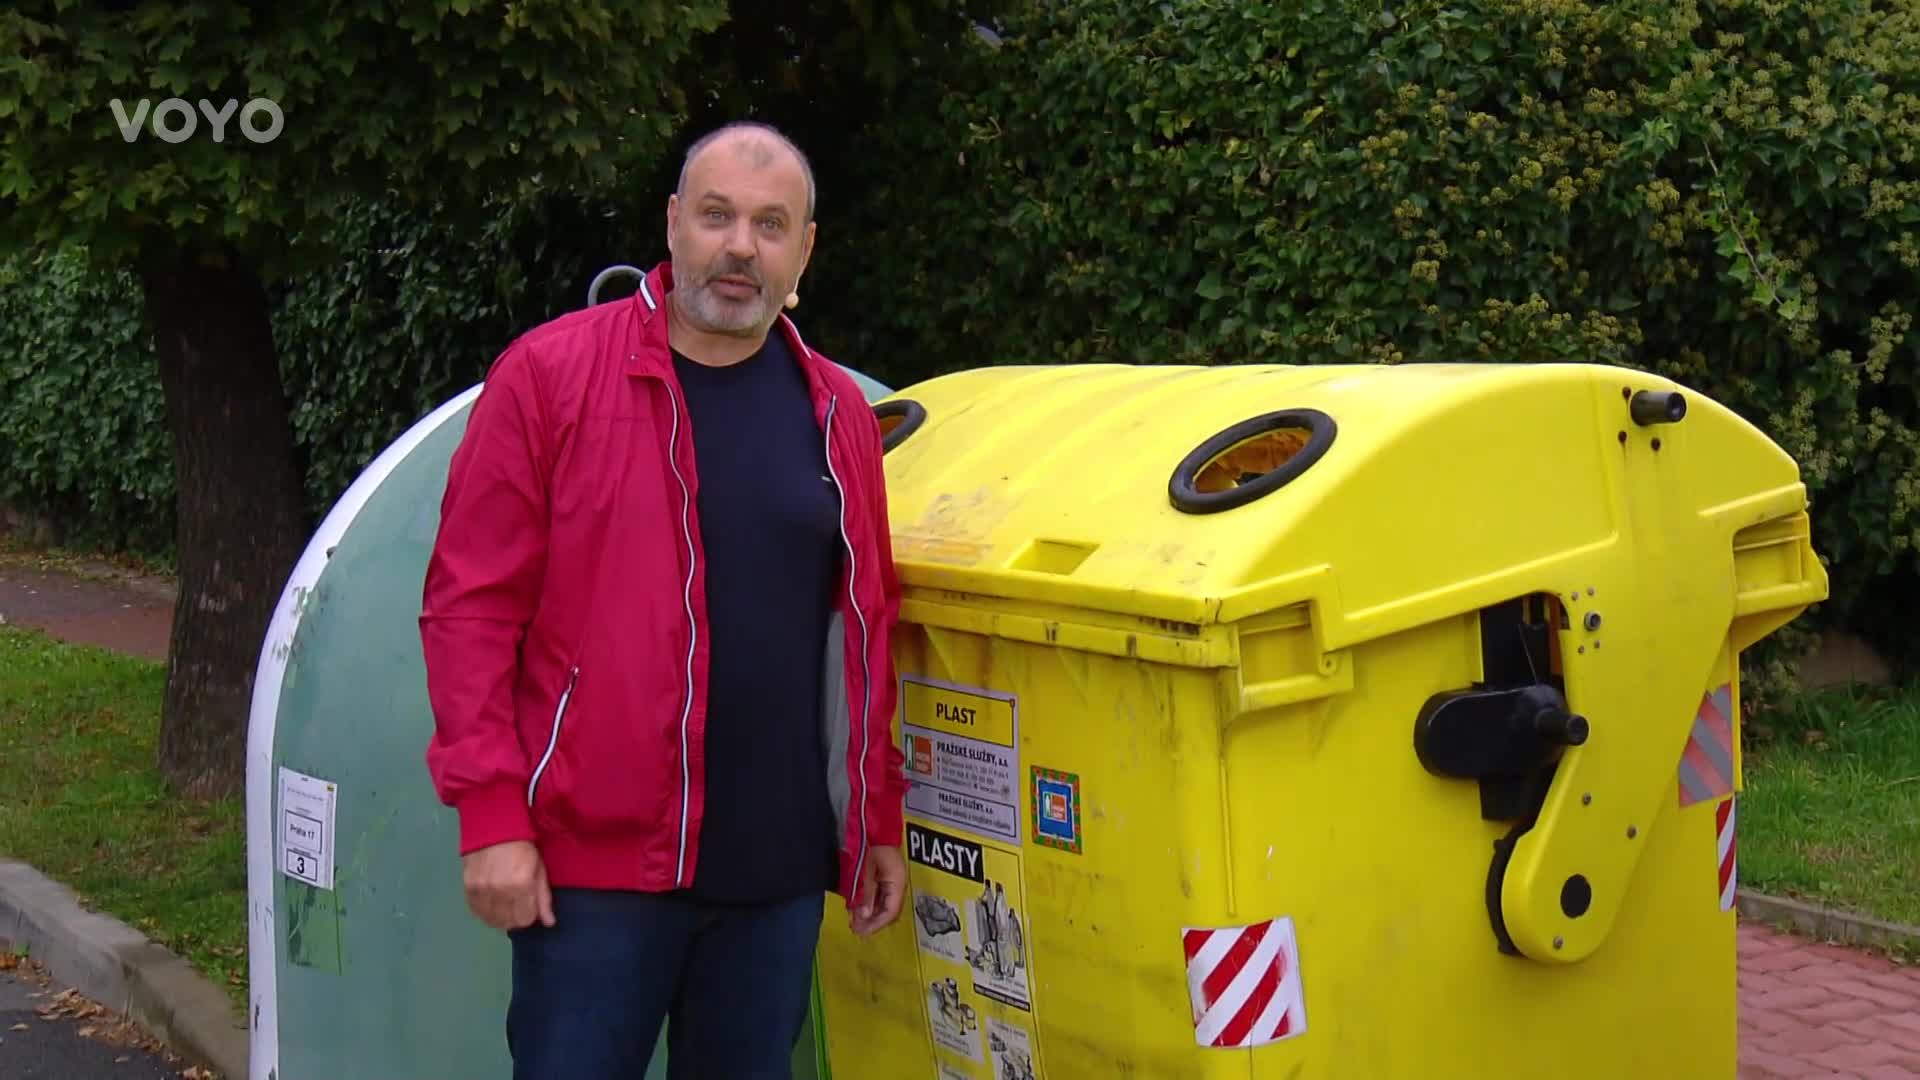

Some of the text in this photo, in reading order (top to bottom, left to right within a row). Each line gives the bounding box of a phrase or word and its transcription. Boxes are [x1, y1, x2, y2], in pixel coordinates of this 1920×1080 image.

[936, 703, 976, 726] PLAST
[297, 856, 305, 874] 3
[910, 831, 978, 877] PLASTY
